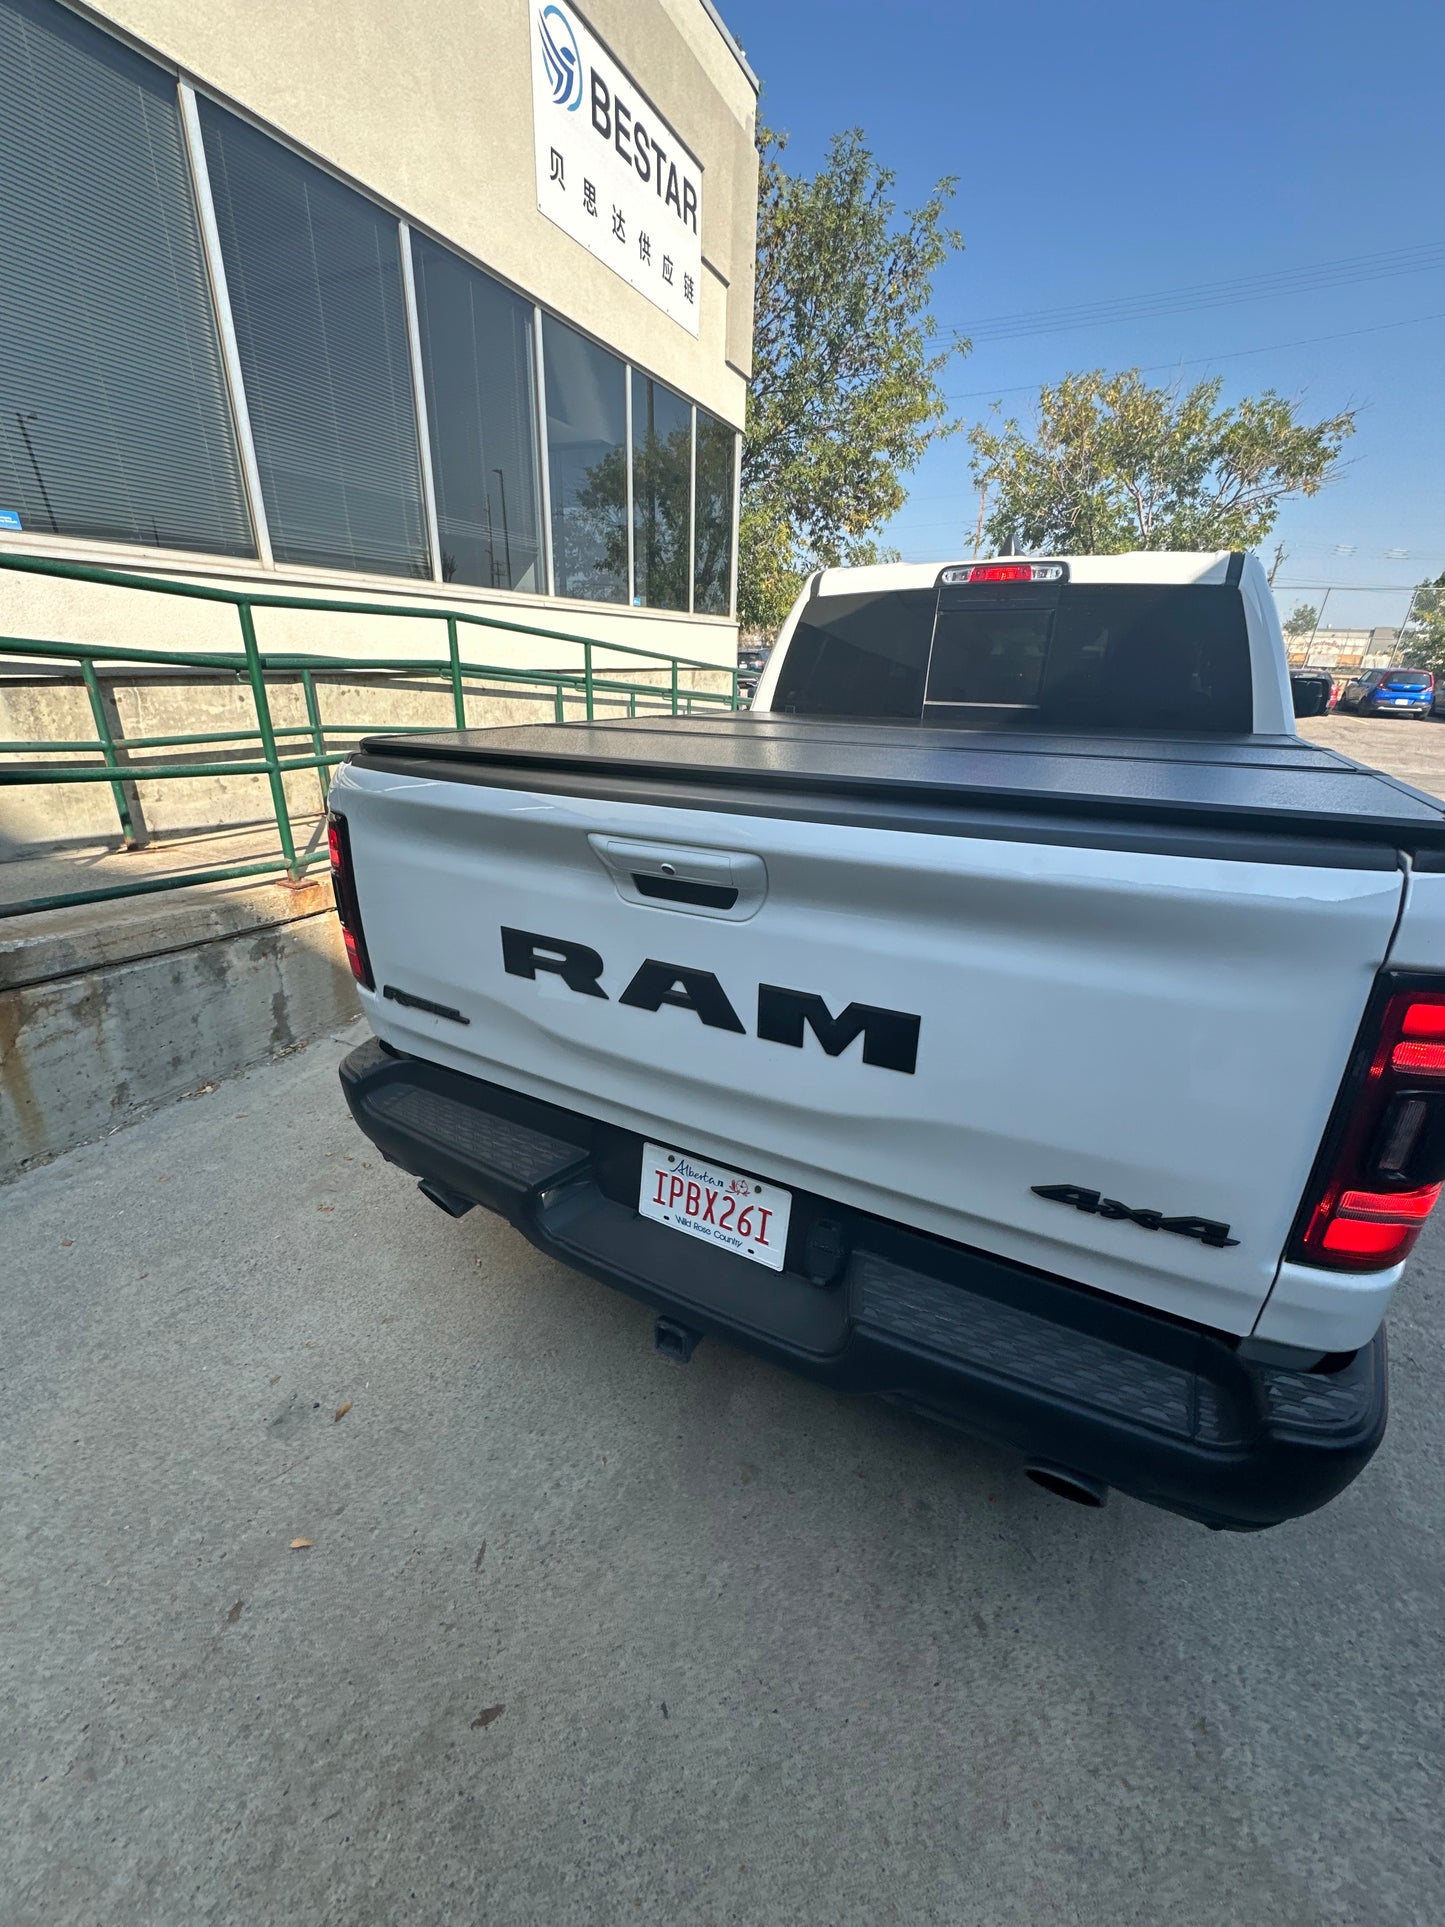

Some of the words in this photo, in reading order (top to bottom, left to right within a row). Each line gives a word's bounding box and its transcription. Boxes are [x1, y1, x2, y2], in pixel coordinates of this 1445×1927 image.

[550, 146, 694, 304] 贝思达供应链
[591, 66, 697, 236] BESTAR
[500, 925, 921, 1074] RAM
[669, 1160, 724, 1188] Alberta
[674, 1214, 692, 1229] Wild
[693, 1222, 712, 1235] Rose
[713, 1230, 743, 1248] Country
